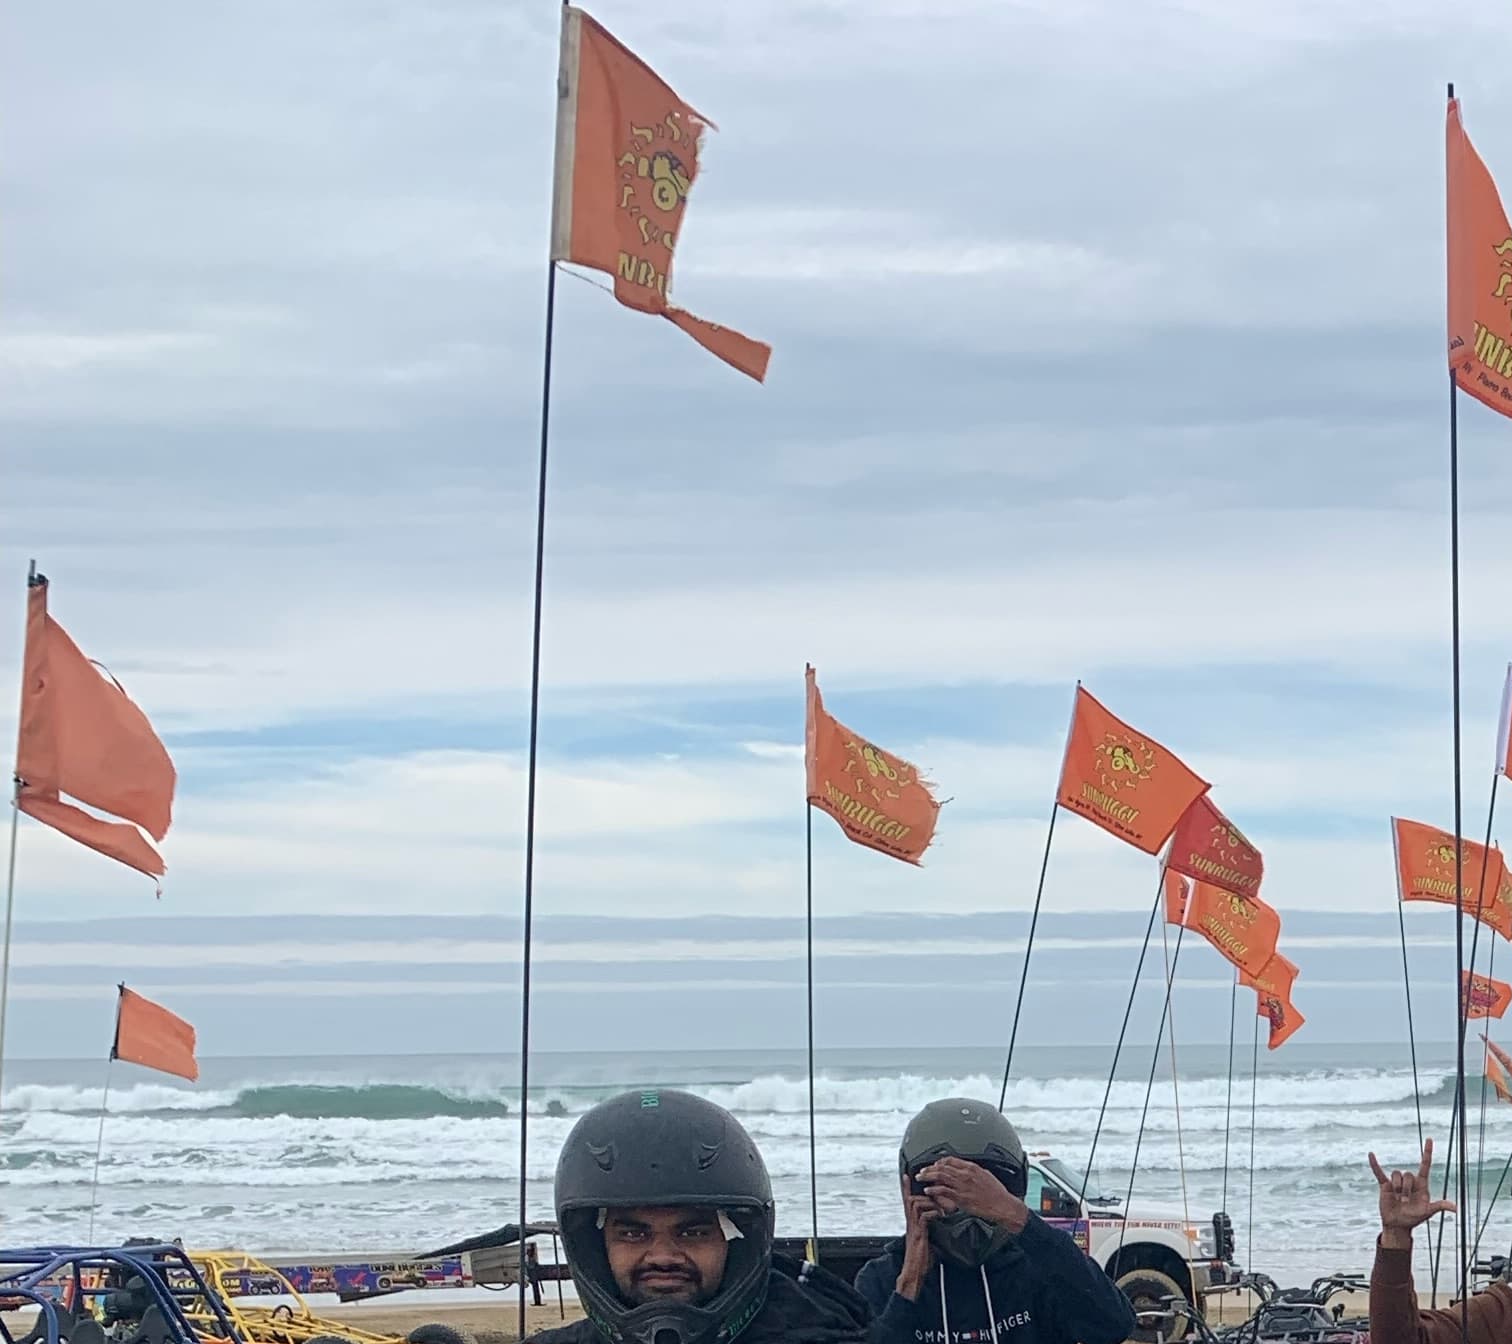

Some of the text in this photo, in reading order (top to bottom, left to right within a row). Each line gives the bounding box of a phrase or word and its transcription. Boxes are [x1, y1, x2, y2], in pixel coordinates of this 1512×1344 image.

[1188, 852, 1259, 890] SUNBUGGY
[1402, 874, 1473, 897] SUNBUGY
[979, 1310, 1031, 1341] HIFIGER
